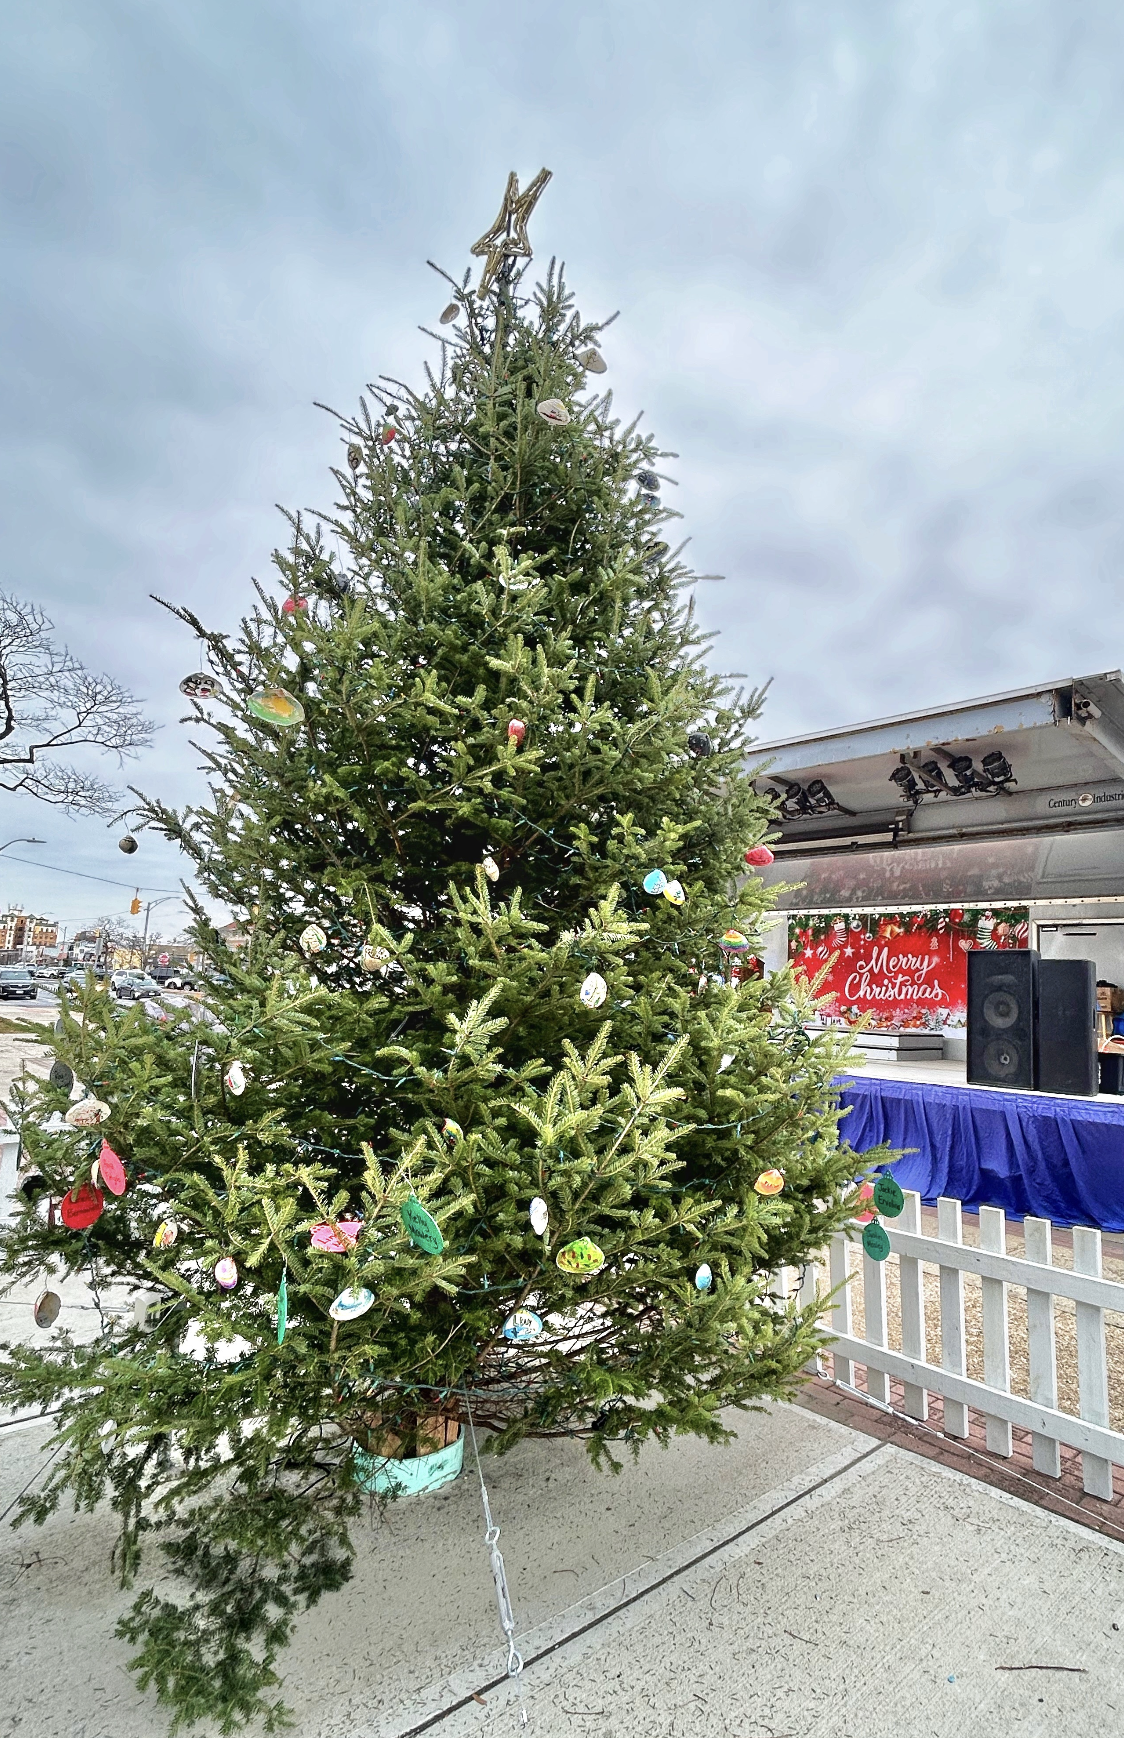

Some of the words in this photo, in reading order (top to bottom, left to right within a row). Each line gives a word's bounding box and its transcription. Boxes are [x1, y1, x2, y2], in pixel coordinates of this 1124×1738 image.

[1048, 798, 1077, 809] Century
[857, 946, 938, 983] Merry
[845, 972, 950, 1002] Christmas
